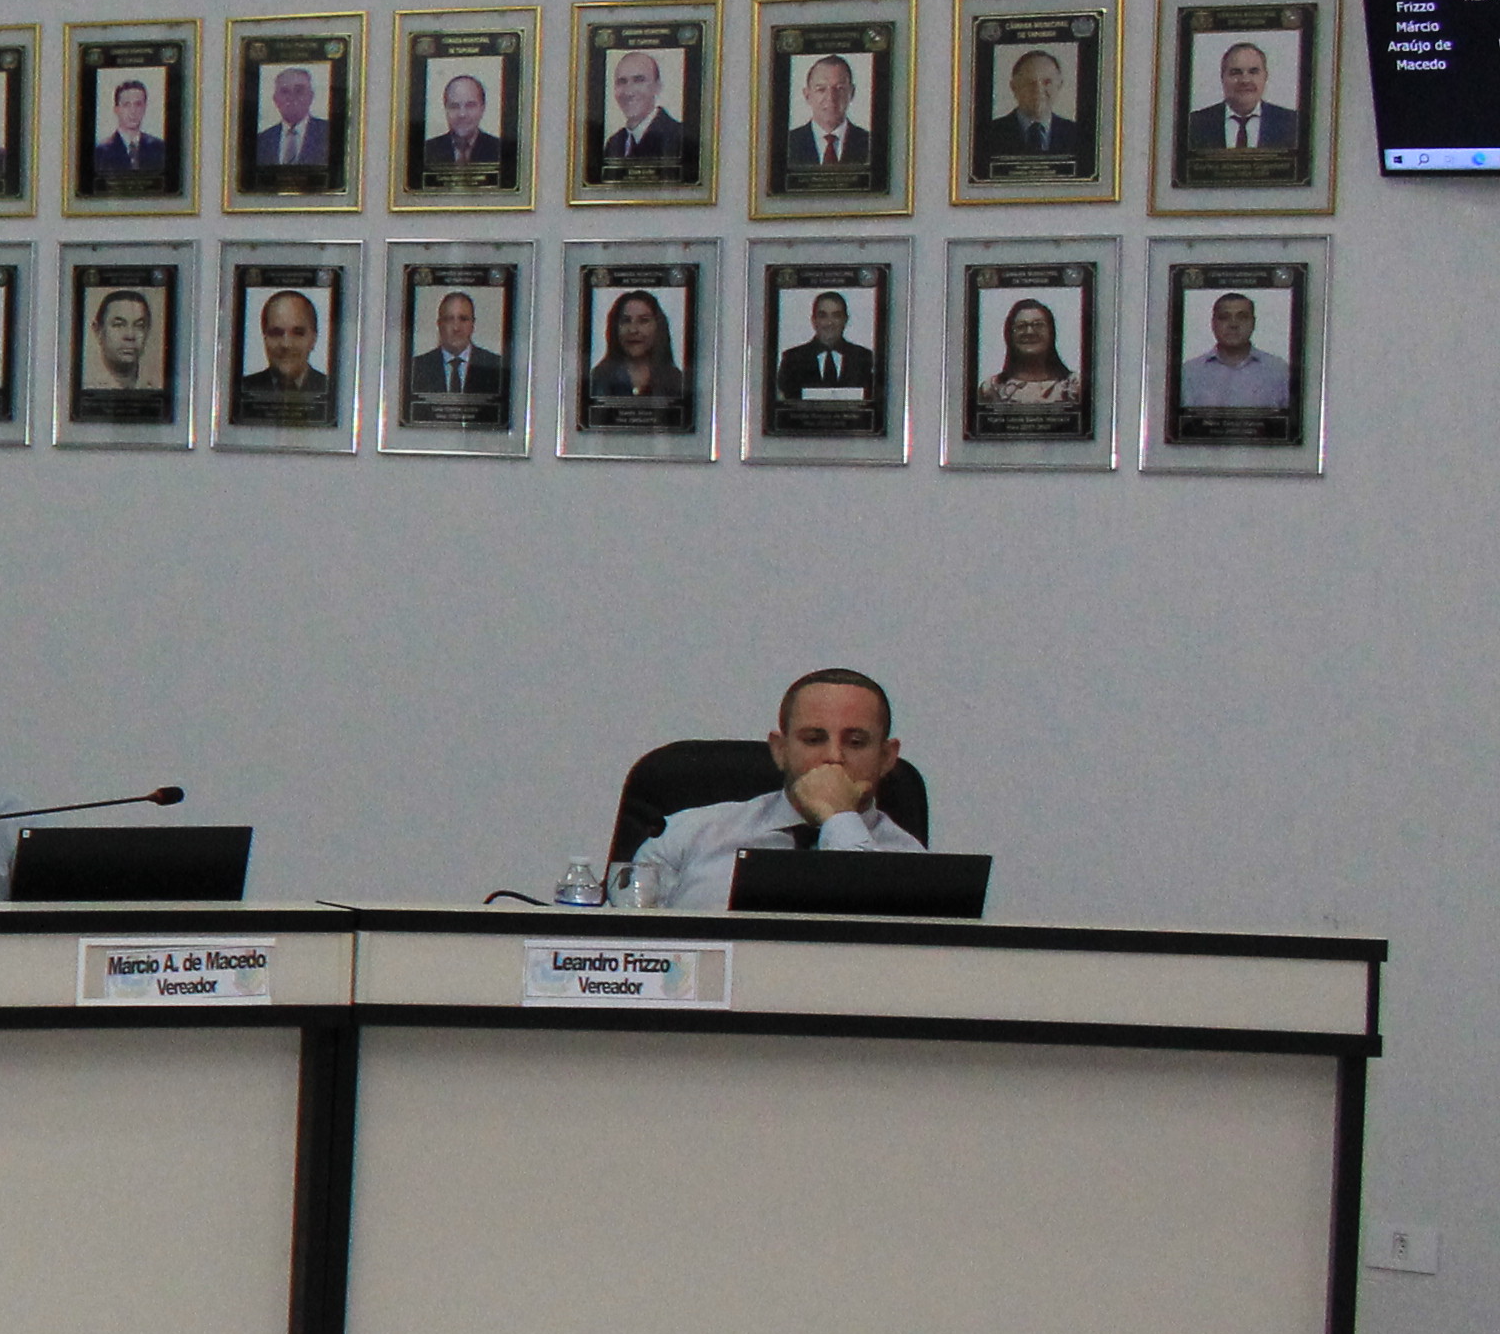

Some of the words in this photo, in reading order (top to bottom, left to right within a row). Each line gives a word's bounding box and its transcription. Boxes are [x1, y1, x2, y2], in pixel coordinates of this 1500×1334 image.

[1395, 0, 1436, 13] Frizzo
[1395, 18, 1440, 33] Márcio
[1387, 38, 1431, 54] Araújo
[1434, 38, 1452, 50] de
[1396, 57, 1447, 70] Macedo
[108, 954, 160, 976] Márcio
[163, 953, 179, 973] A.
[182, 952, 202, 972] de
[205, 949, 267, 971] Macedo
[552, 951, 619, 972] Leandro
[623, 952, 671, 973] Frizzo
[157, 976, 218, 996] Vereador
[578, 975, 643, 995] Vereador
